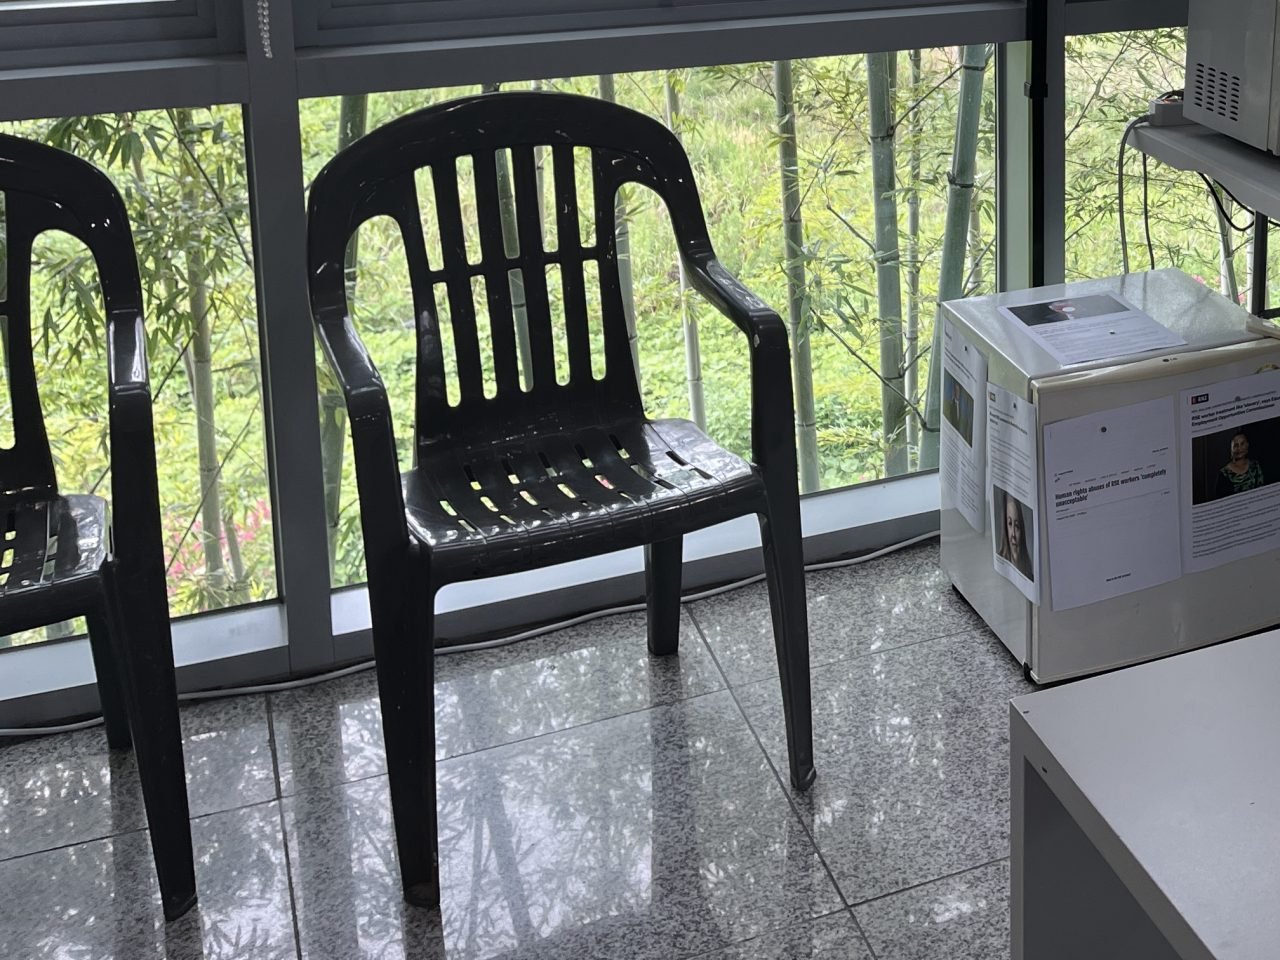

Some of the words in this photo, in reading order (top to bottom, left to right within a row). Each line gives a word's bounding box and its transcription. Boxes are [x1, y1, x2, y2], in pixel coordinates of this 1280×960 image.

[1055, 491, 1072, 500] Human
[1073, 488, 1087, 496] rights
[1088, 484, 1105, 492] abuses
[1121, 476, 1140, 485] workers
